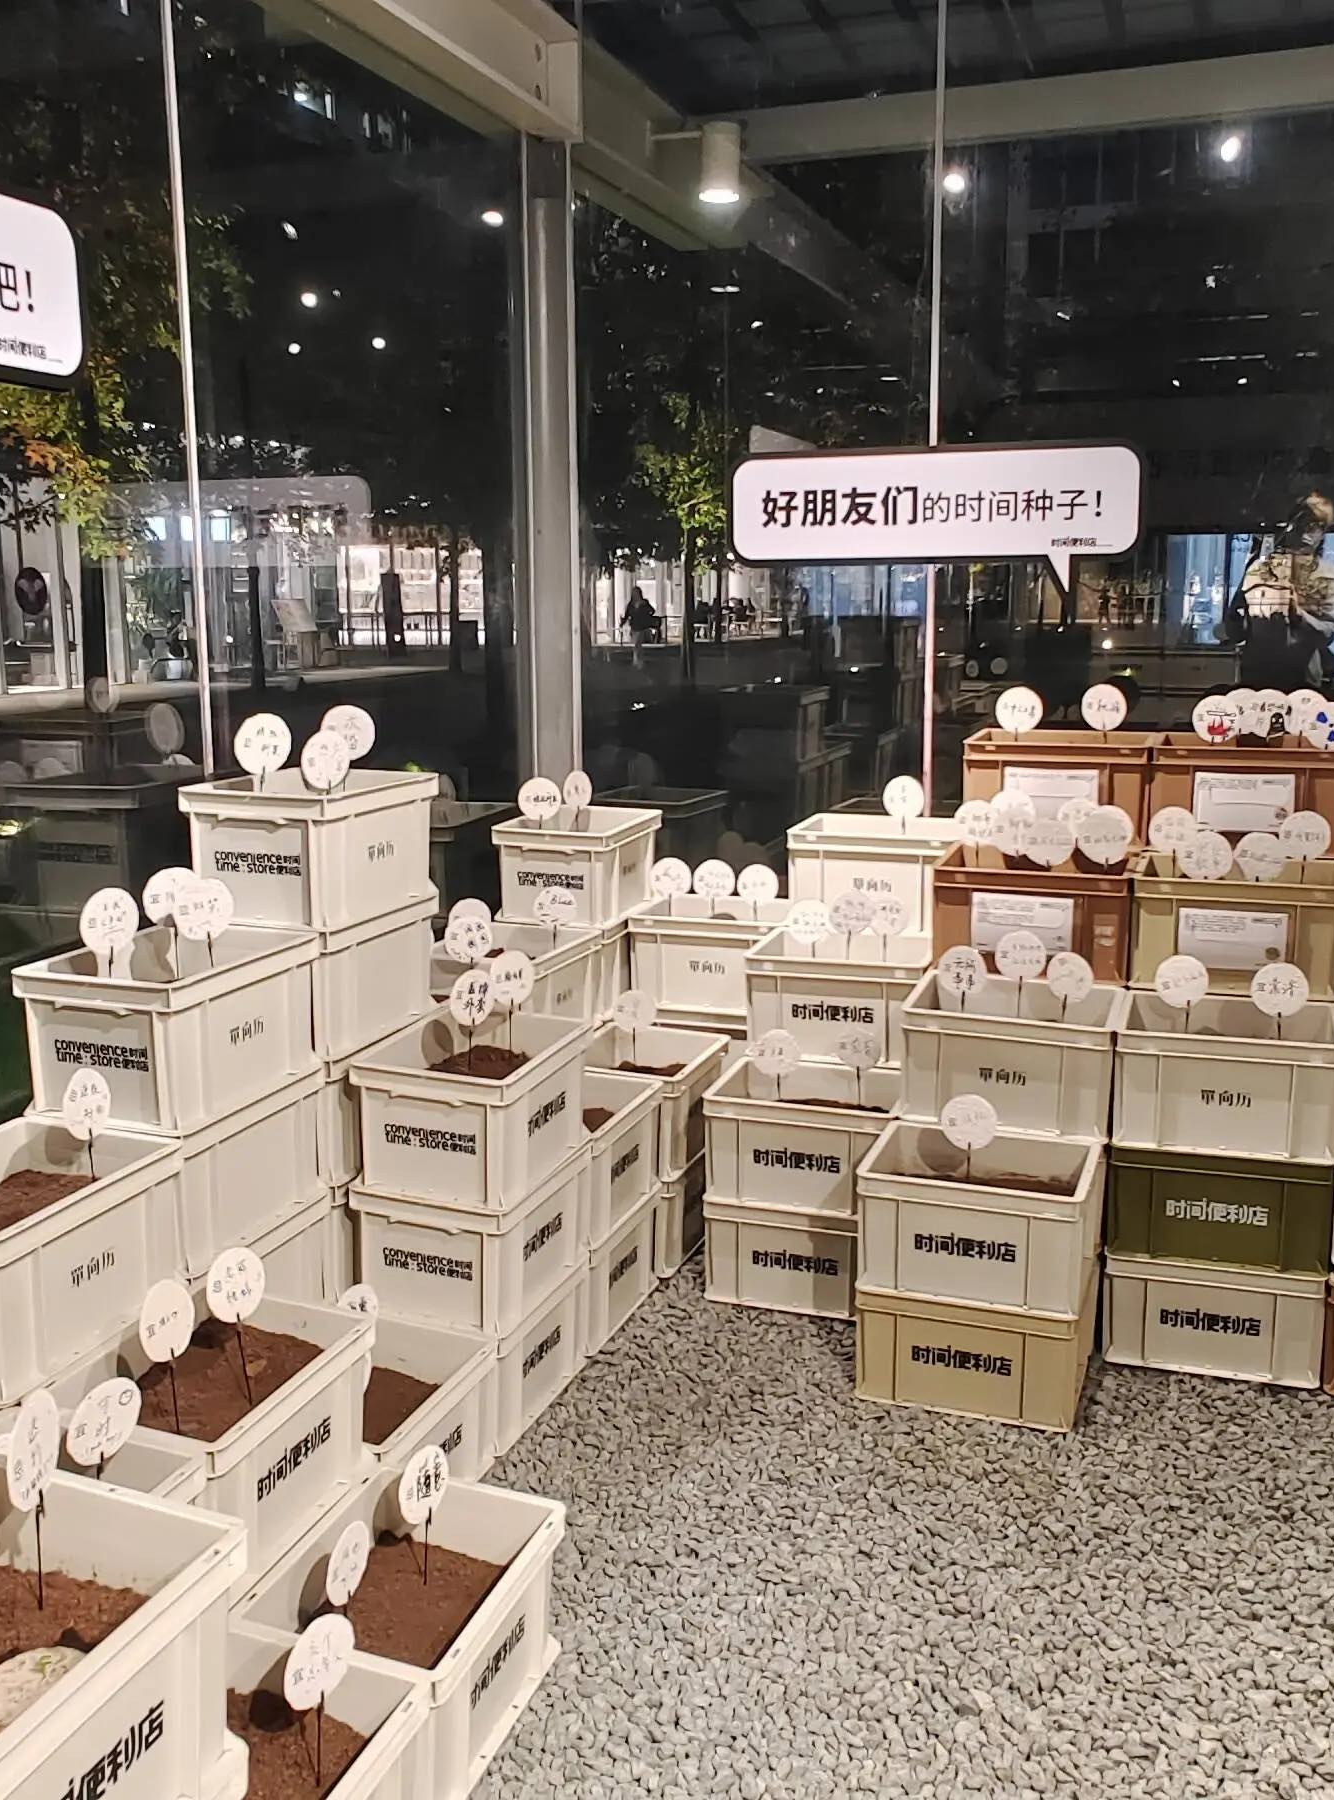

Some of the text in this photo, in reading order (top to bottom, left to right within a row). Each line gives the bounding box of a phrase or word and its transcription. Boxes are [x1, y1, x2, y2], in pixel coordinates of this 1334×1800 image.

[761, 485, 1103, 529] 好朋友们的时间种子！
[214, 850, 283, 865] convenience
[790, 1000, 875, 1025] 时间便利店
[54, 1039, 129, 1058] convenience
[383, 1122, 457, 1141] convenience
[752, 1147, 841, 1175] 时间便利店
[1164, 1197, 1270, 1228] 时间便利店
[914, 1231, 1017, 1264] 时间便利店
[751, 1250, 839, 1277] 时间便利店
[1158, 1307, 1262, 1338] 时间便利店
[911, 1344, 1013, 1377] 时间便利店
[255, 1414, 333, 1504] 时间便利店
